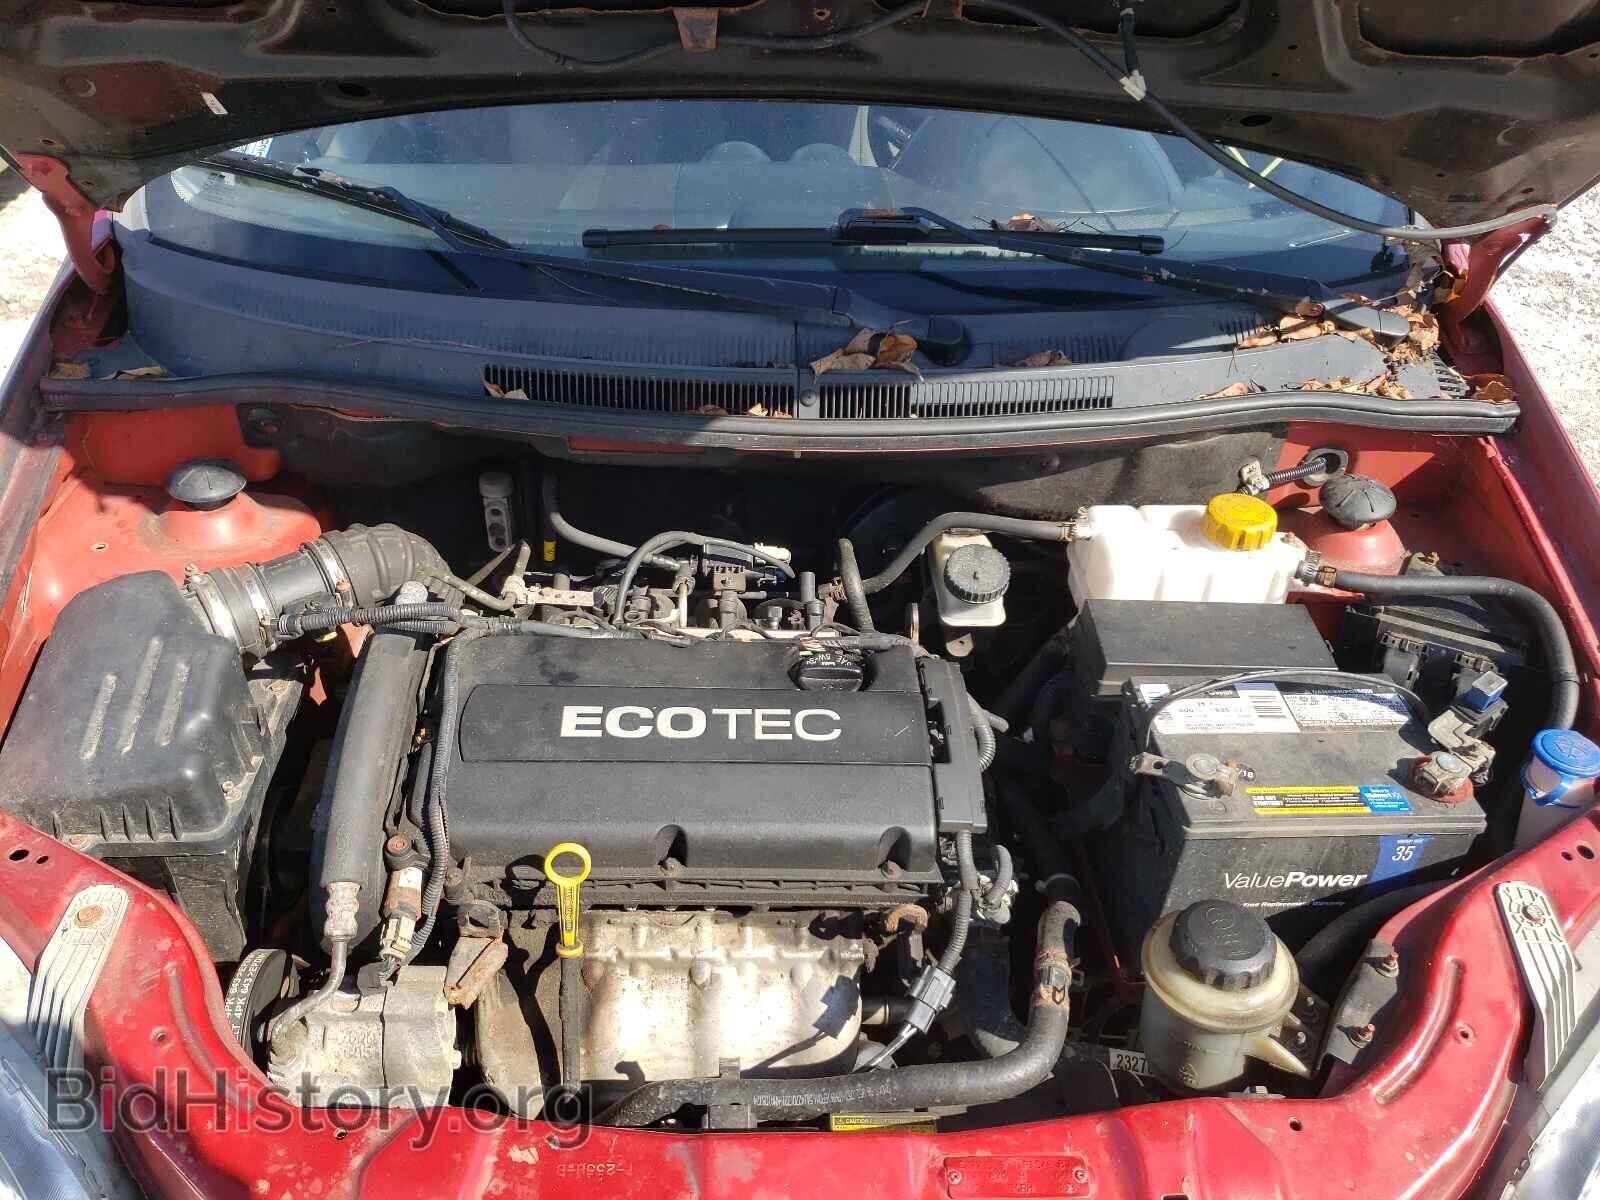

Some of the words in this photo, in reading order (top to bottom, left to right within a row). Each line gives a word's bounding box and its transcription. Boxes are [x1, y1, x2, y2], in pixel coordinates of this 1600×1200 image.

[560, 705, 843, 741] ECOTEC
[1392, 845, 1416, 861] 35
[1223, 871, 1368, 889] ValuePower
